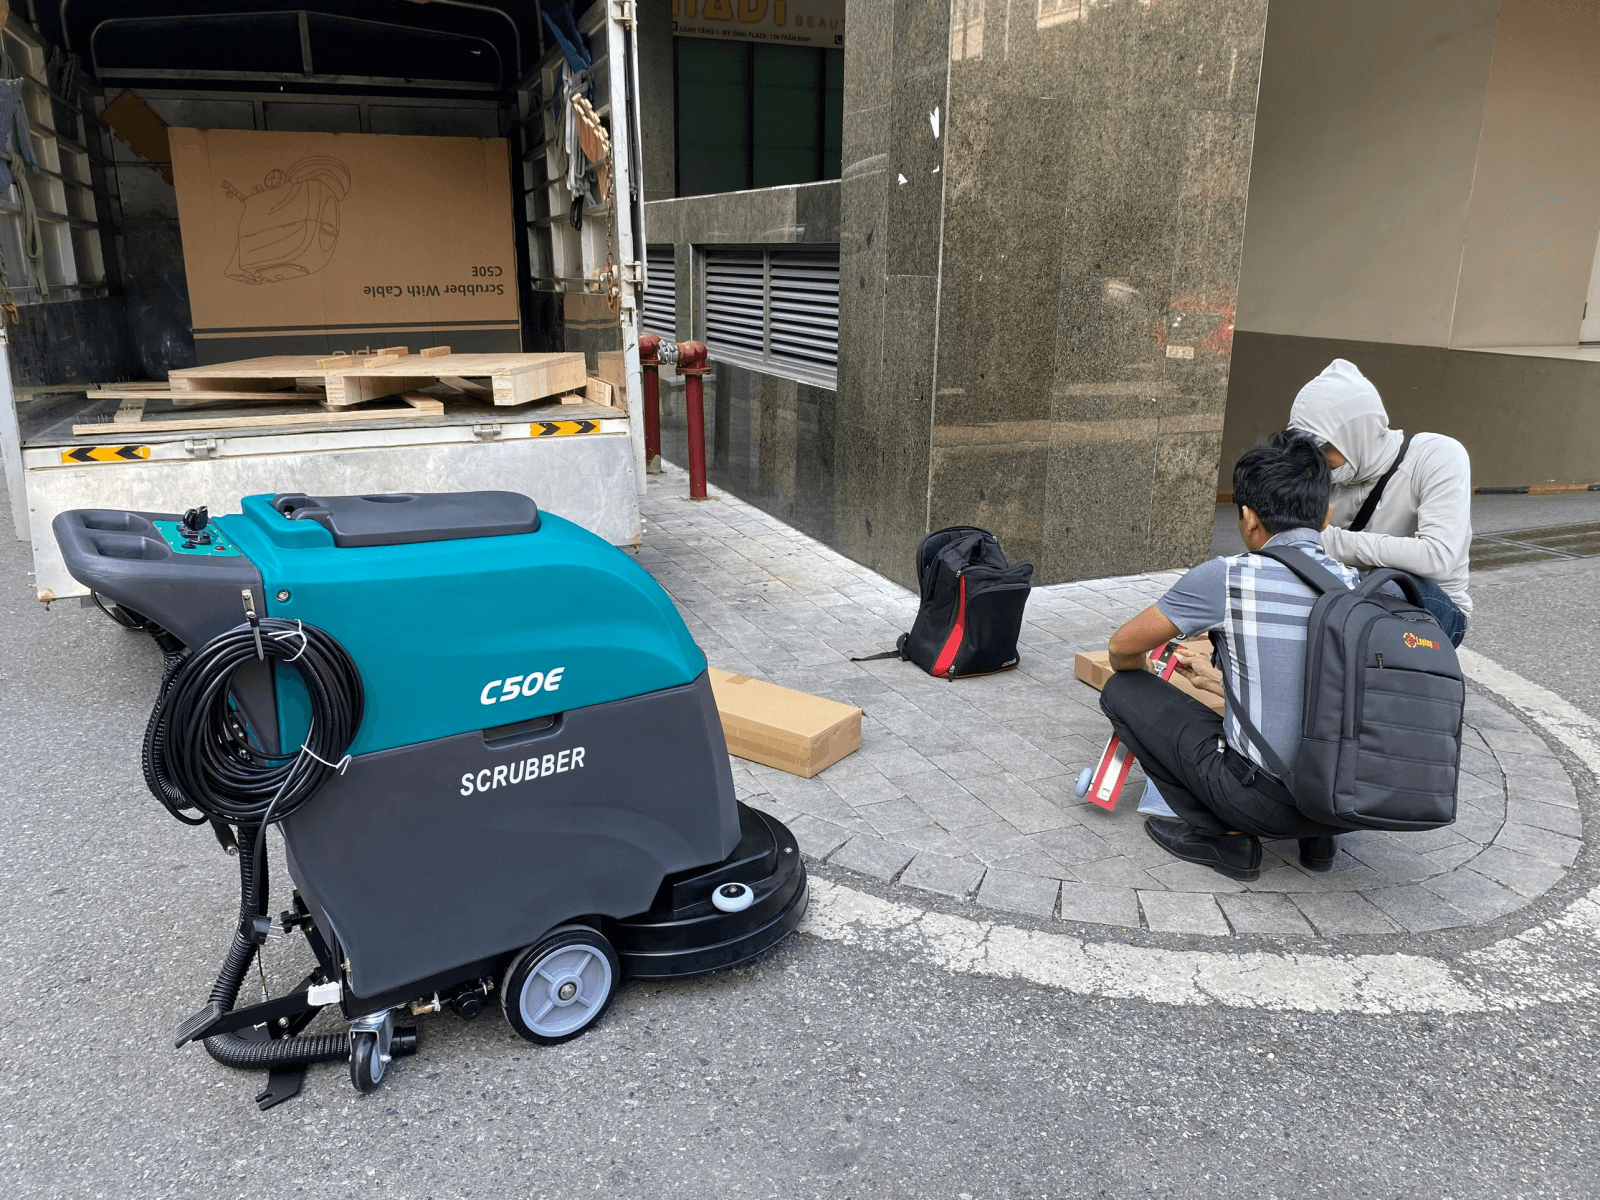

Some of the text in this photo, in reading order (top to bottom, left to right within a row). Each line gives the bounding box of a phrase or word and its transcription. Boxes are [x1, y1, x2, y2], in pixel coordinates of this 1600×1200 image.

[471, 266, 503, 277] C50E
[363, 284, 504, 298] Scrubber With Cable
[480, 666, 565, 705] C50E
[460, 746, 586, 796] SCRUBBER
